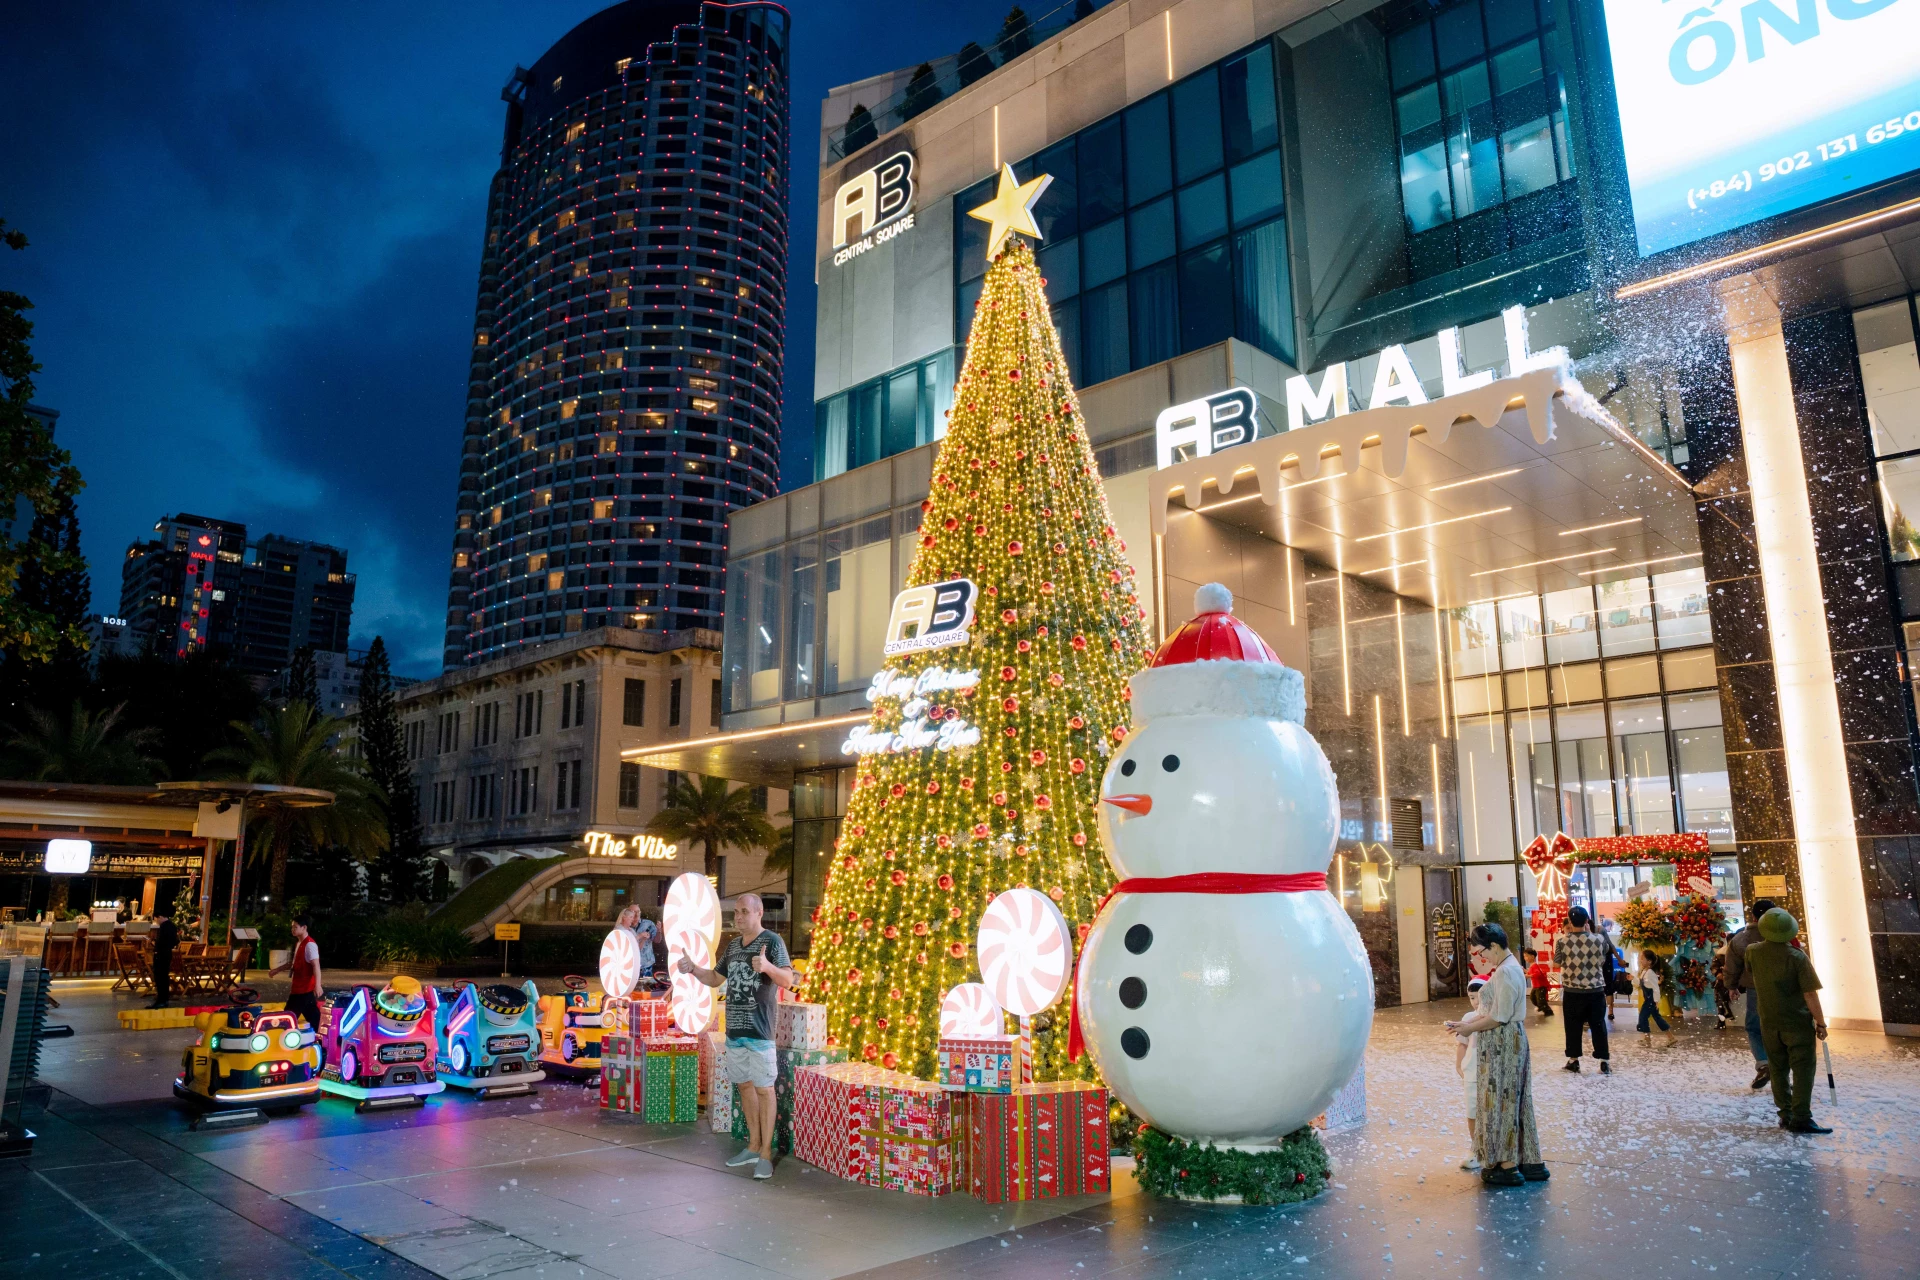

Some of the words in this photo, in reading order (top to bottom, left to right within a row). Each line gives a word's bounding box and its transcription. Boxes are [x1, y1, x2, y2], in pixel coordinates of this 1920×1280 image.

[1687, 170, 1752, 210] (+84)
[1758, 150, 1812, 182] 902
[1816, 133, 1858, 161] 131
[1865, 110, 1920, 144] 650
[832, 150, 914, 249] AB
[833, 236, 874, 267] CENTRAL
[875, 213, 915, 245] SQUARE
[1156, 386, 1259, 472] AB
[1285, 303, 1570, 432] MALL
[190, 551, 215, 562] MAPLE
[102, 616, 127, 627] BOSS
[885, 577, 974, 642] AB
[884, 637, 924, 653] CENTRAL
[925, 631, 963, 646] SQUARE
[584, 831, 627, 857] The
[631, 835, 678, 860] Vibe
